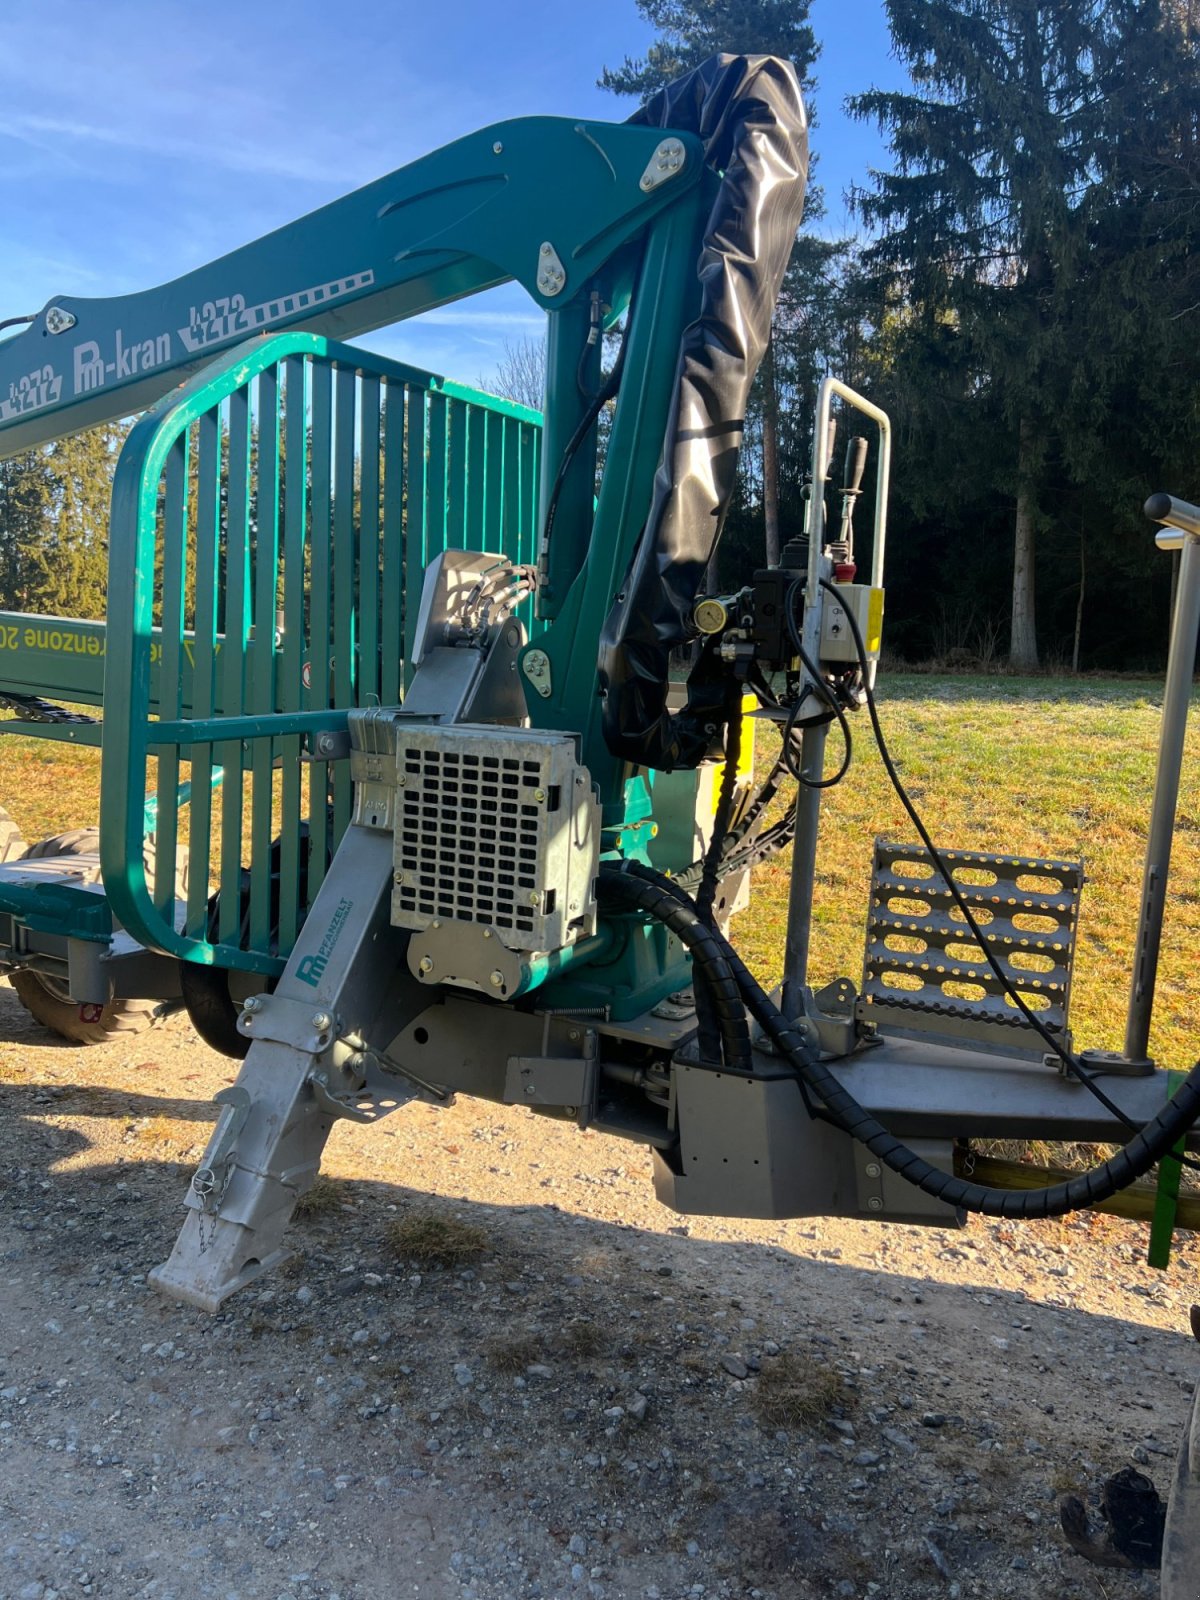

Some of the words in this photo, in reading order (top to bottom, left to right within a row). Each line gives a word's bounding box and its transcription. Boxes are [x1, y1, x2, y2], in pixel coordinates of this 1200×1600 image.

[9, 364, 57, 413] 4272
[190, 294, 248, 346] 4272
[318, 897, 349, 956] PFANZELT
